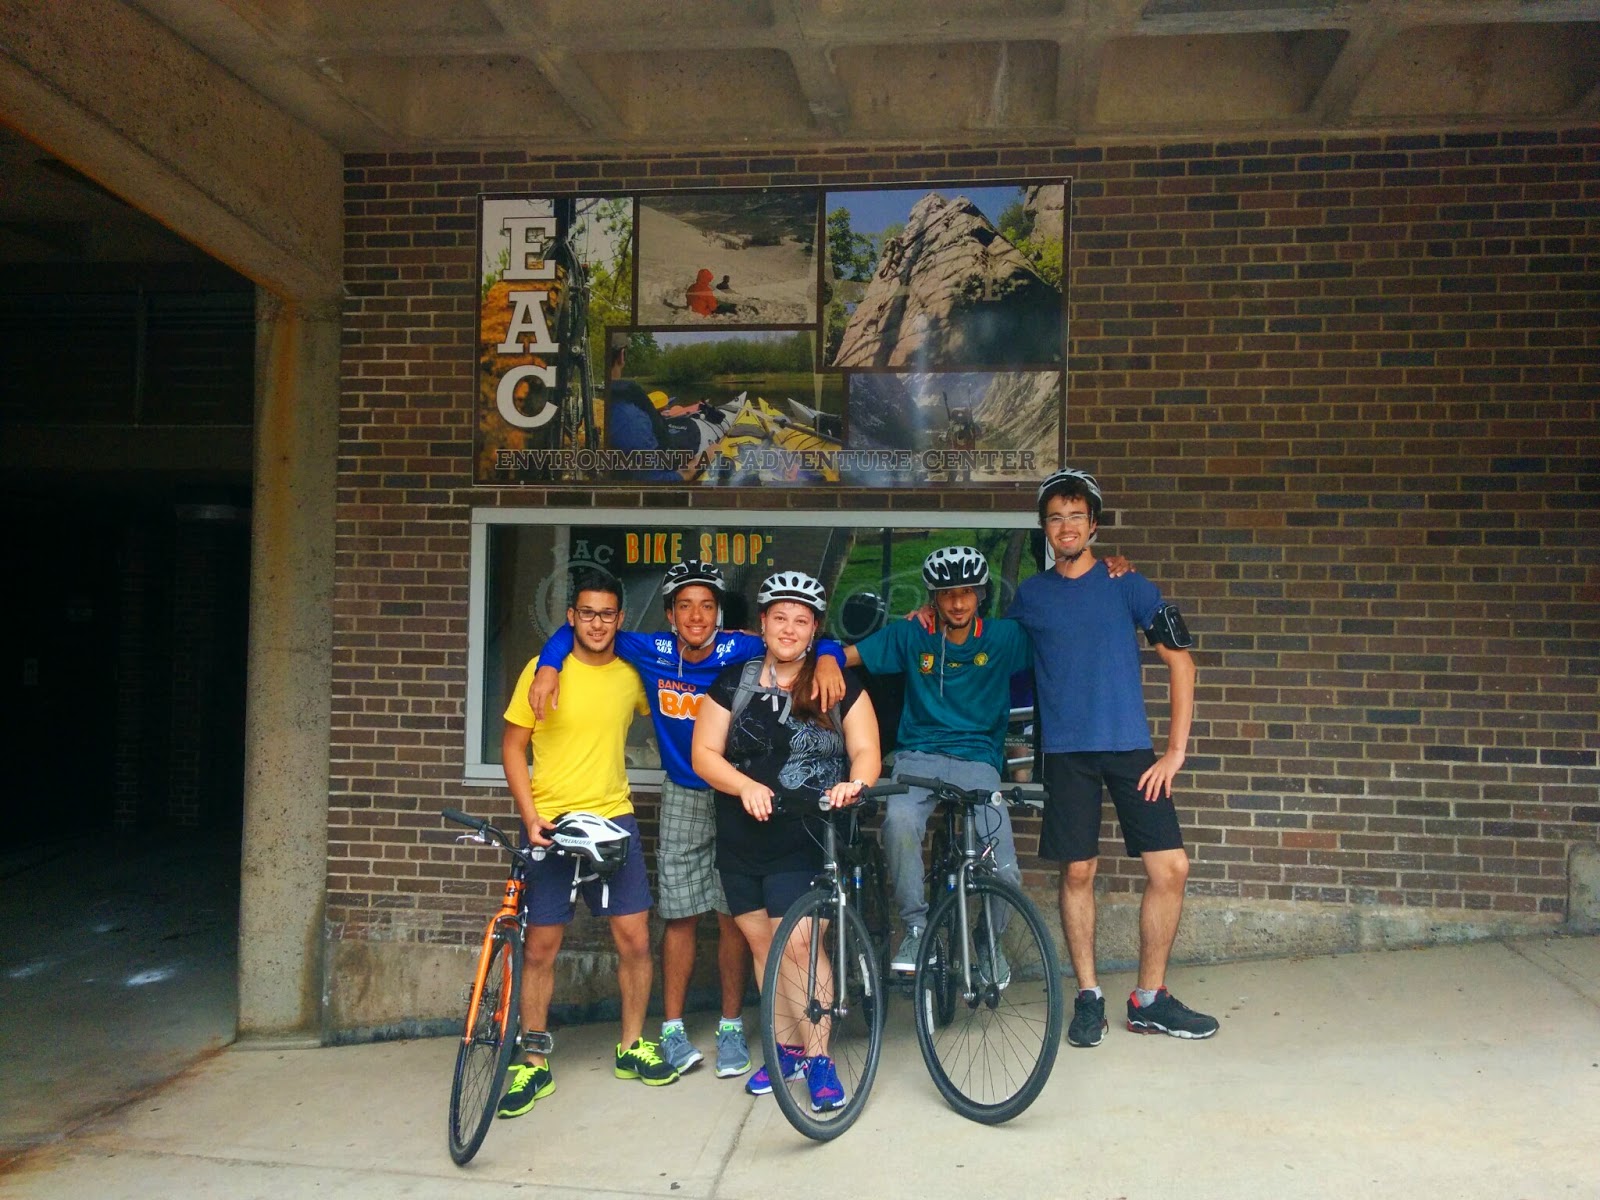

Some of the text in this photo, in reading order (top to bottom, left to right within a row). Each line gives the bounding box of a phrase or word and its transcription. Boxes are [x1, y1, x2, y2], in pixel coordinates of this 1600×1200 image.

[495, 448, 1037, 472] ENVIRONMENTAL ADVENTURE CENTER
[626, 533, 682, 564] BIKE
[658, 679, 696, 693] BANCO
